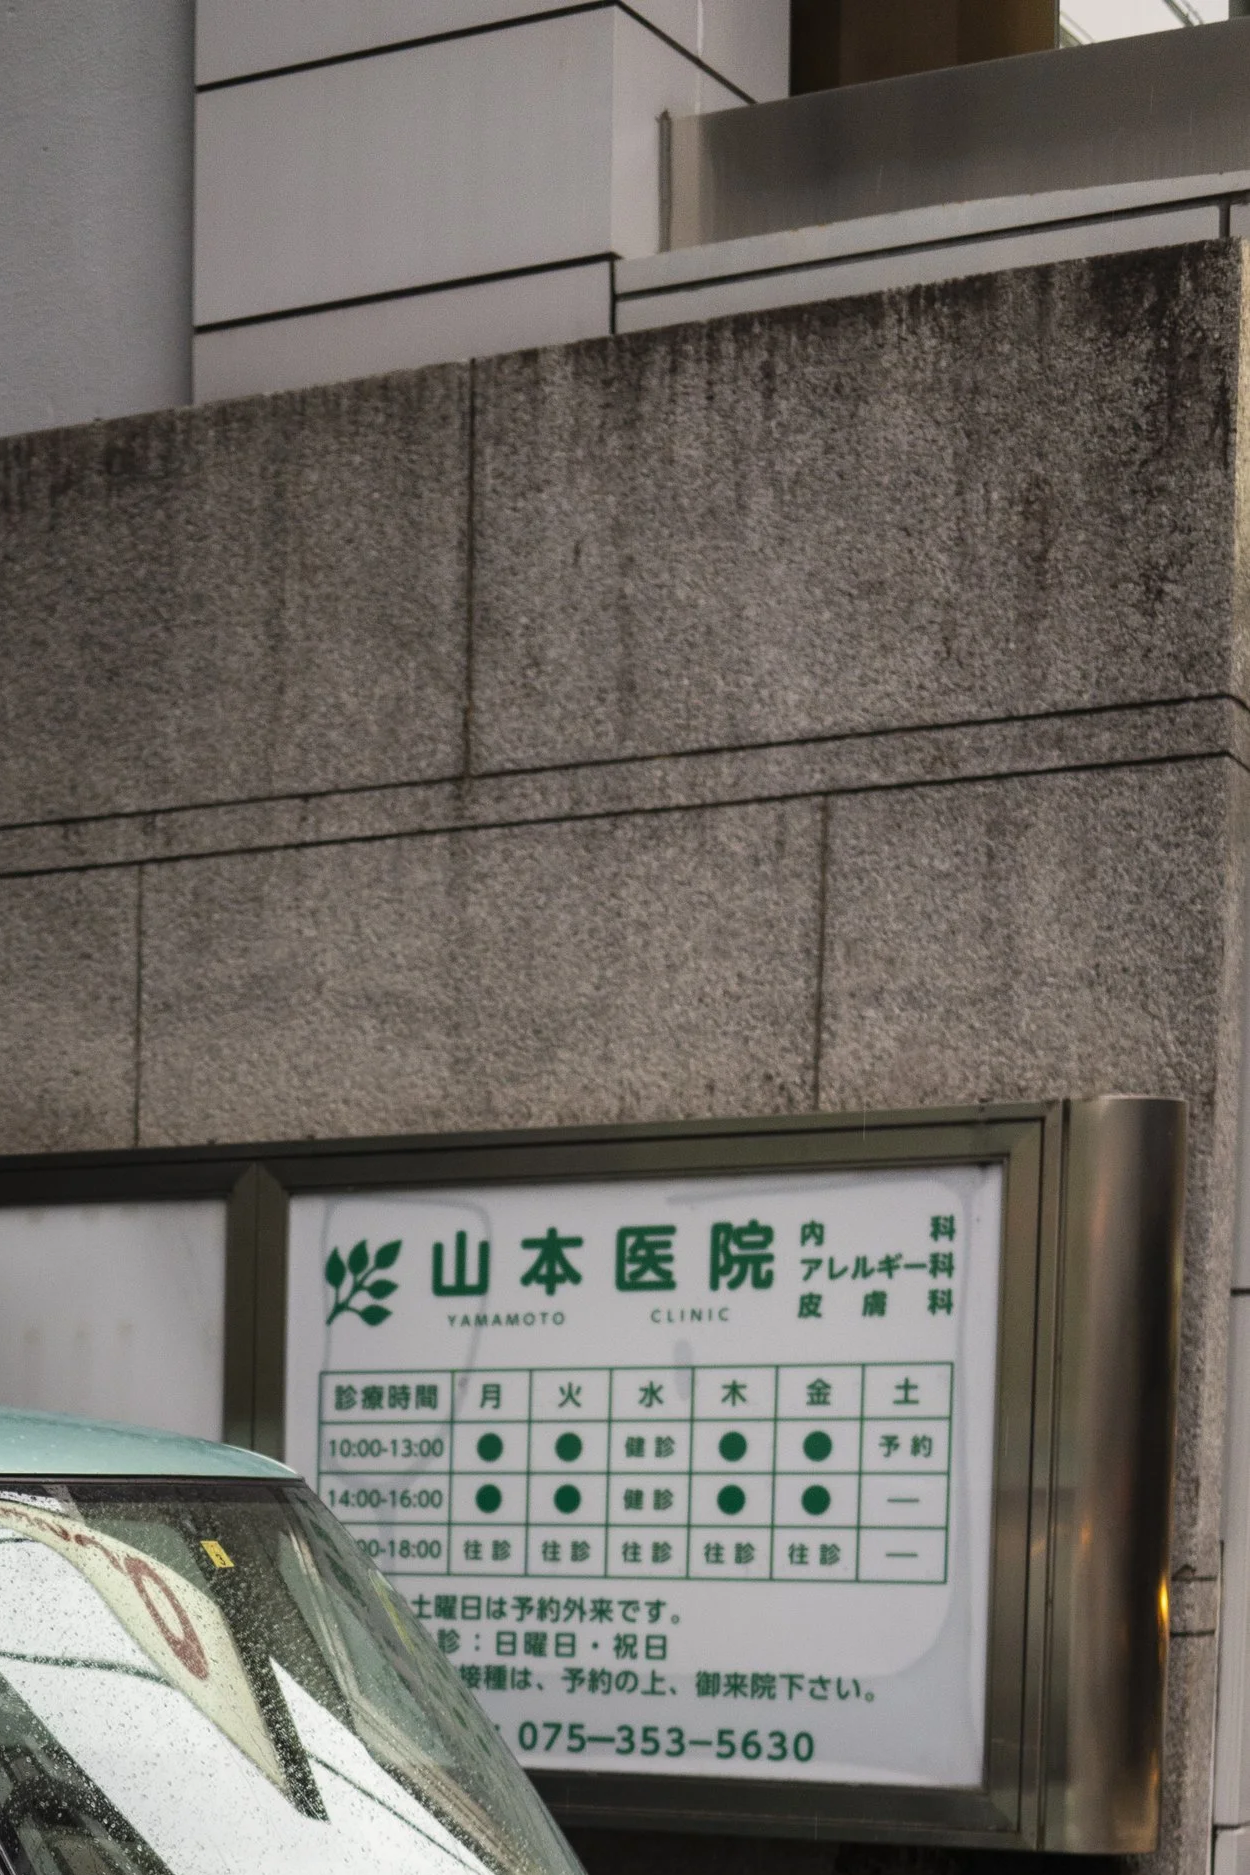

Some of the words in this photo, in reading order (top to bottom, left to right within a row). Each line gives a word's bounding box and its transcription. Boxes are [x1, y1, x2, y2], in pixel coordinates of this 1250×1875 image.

[432, 1219, 775, 1298] 山本医院
[800, 1252, 955, 1282] アレルギー科
[447, 1311, 566, 1329] YAMAMOTO
[650, 1306, 730, 1324] CLINIC
[335, 1385, 438, 1411] 診療時間
[479, 1384, 502, 1410] 月
[558, 1382, 582, 1409] 火
[638, 1381, 664, 1408] 水
[721, 1380, 747, 1407] 木
[806, 1378, 832, 1406] 金
[893, 1378, 920, 1405] 土
[328, 1436, 445, 1459] 10:00-13:00
[625, 1436, 675, 1458] 健診
[879, 1434, 933, 1458] 予約
[328, 1487, 444, 1510] 14:00-16:00
[624, 1488, 674, 1511] 健診
[356, 1539, 443, 1559] 00-18:00
[463, 1540, 512, 1562] 往診
[542, 1540, 591, 1562] 往診
[621, 1541, 673, 1564] 往診
[703, 1542, 756, 1565] 往診
[787, 1543, 841, 1566] 往診
[436, 1629, 668, 1661] 診：日曜日・祝日
[458, 1664, 876, 1704] 接種は、予約の上、御来院下さい。
